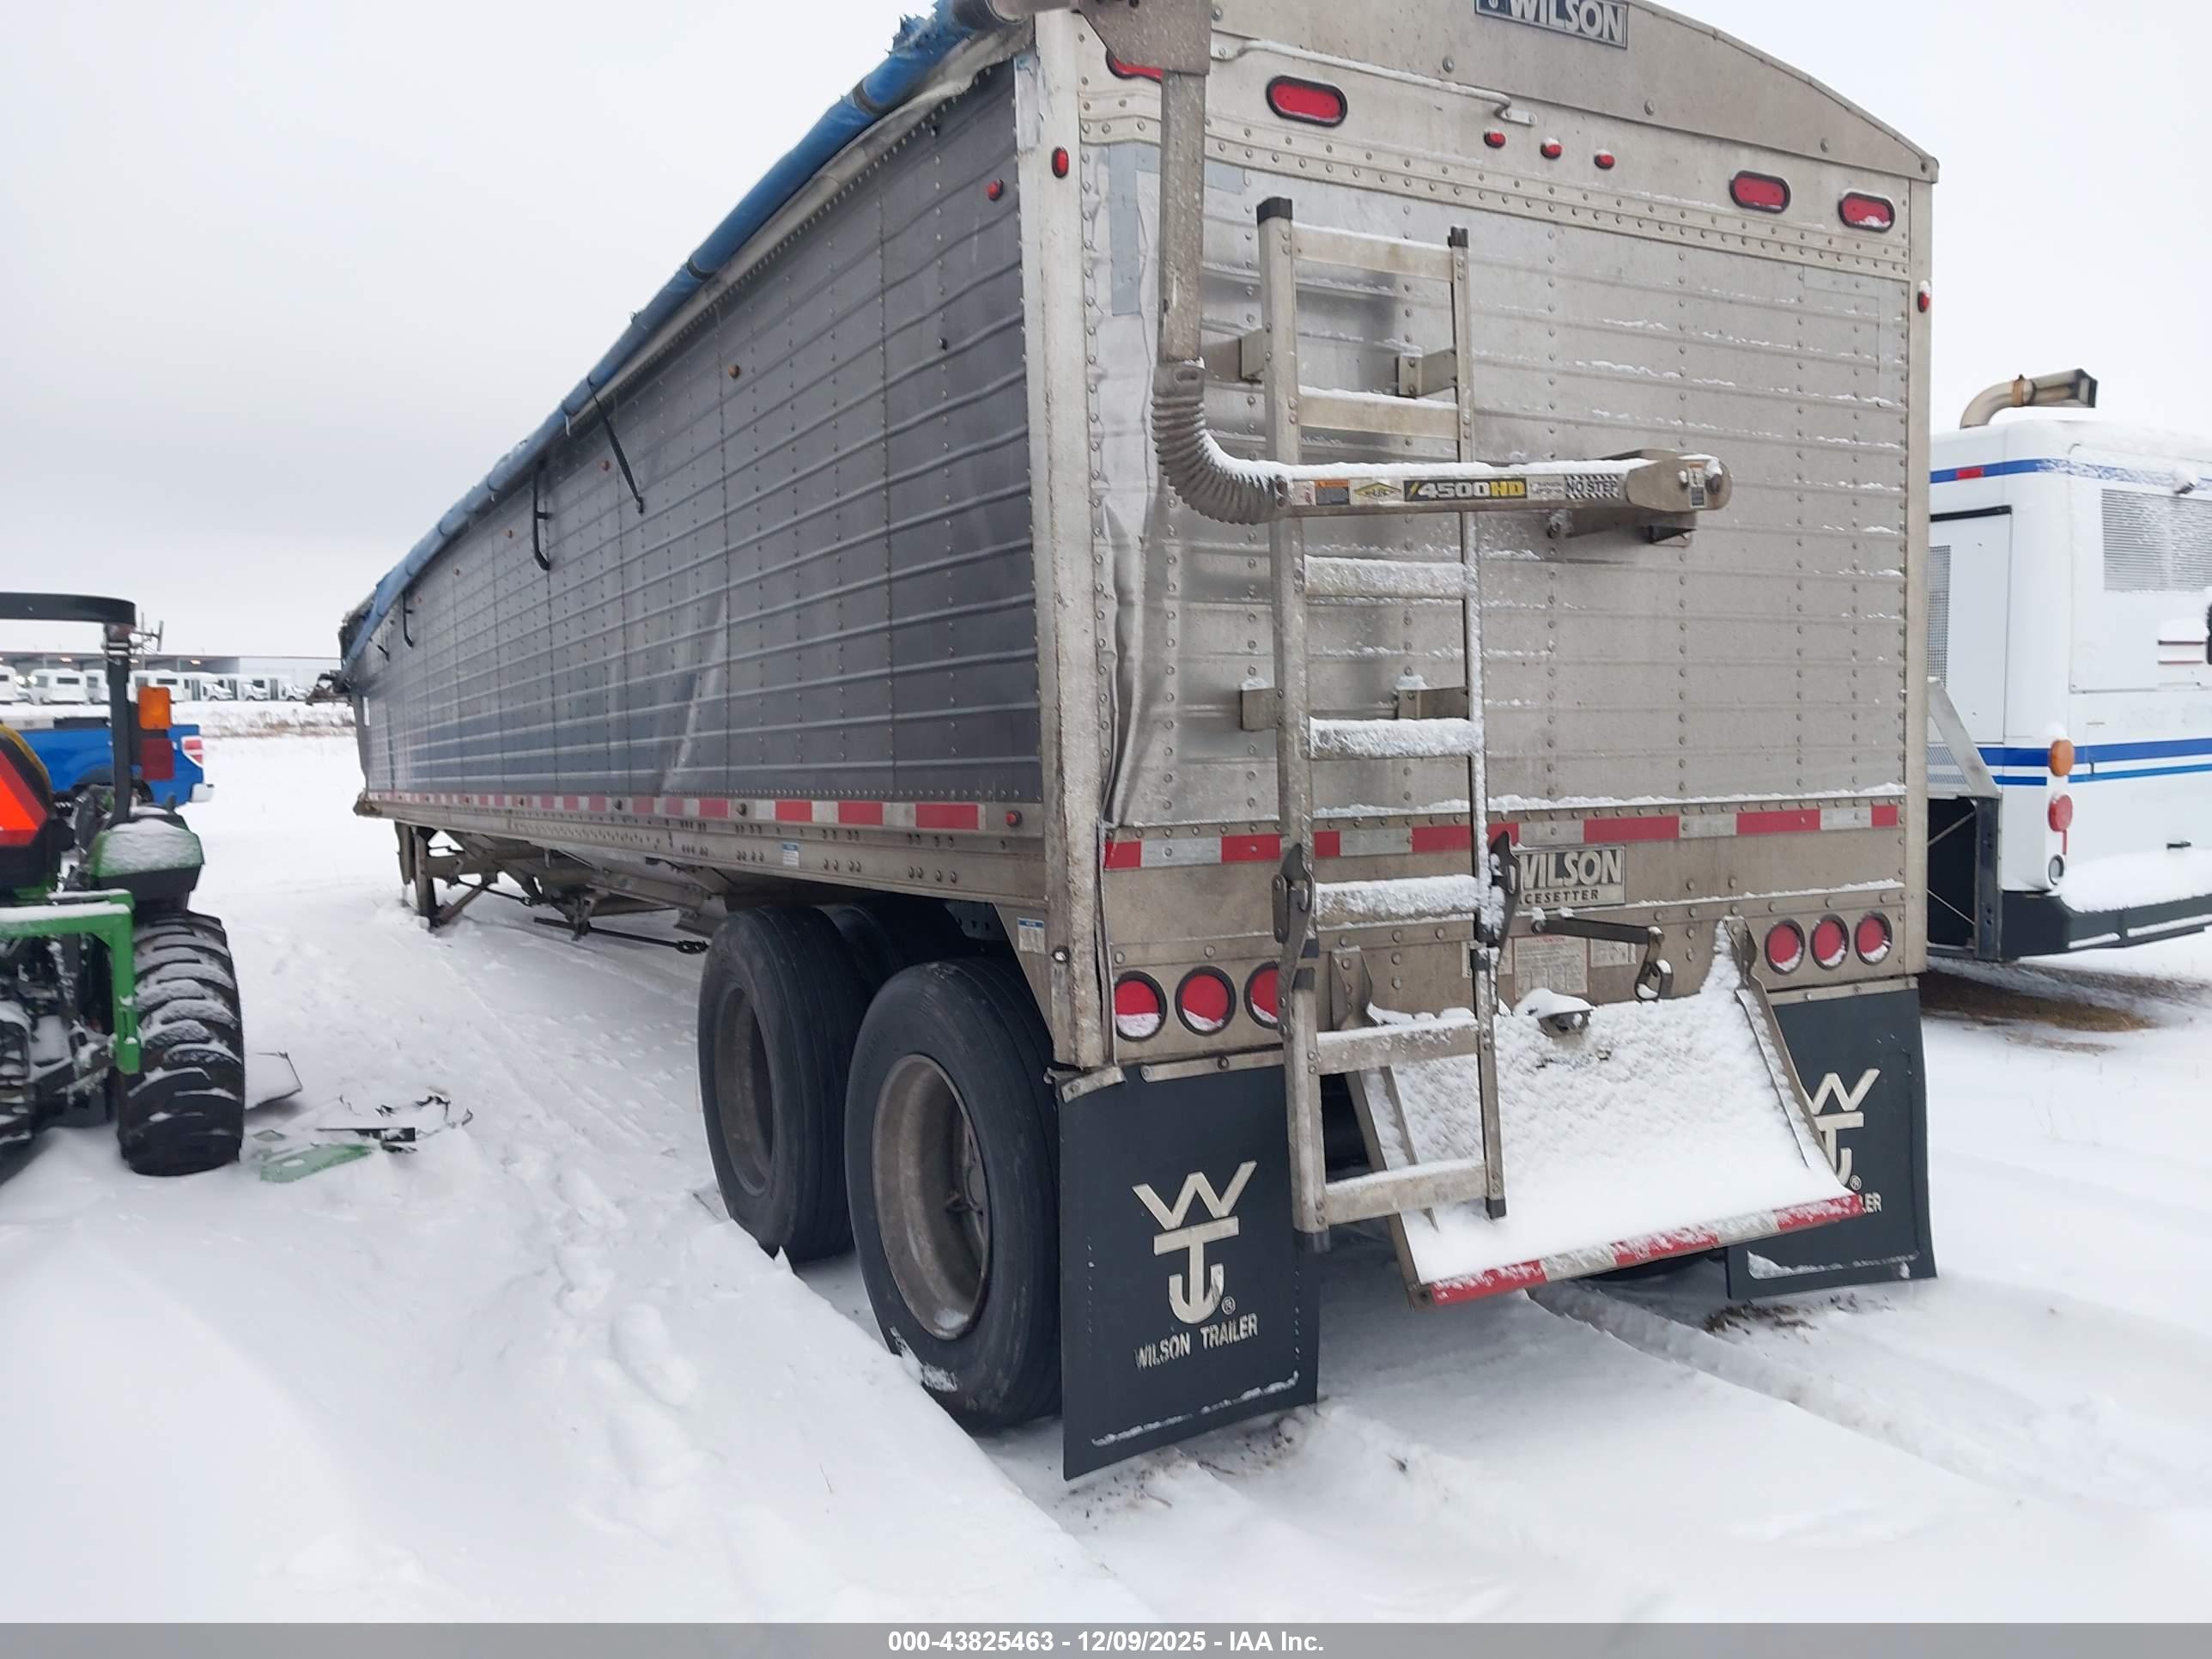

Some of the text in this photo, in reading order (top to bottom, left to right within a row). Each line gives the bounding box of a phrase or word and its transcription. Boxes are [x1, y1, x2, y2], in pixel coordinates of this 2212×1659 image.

[1510, 0, 1623, 42] WILSON
[1418, 480, 1526, 499] 4500HD
[1566, 481, 1584, 494] NO
[1586, 480, 1618, 493] STEP
[1518, 889, 1599, 905] CESETTER
[1133, 1312, 1259, 1370] WILSON TRAILER
